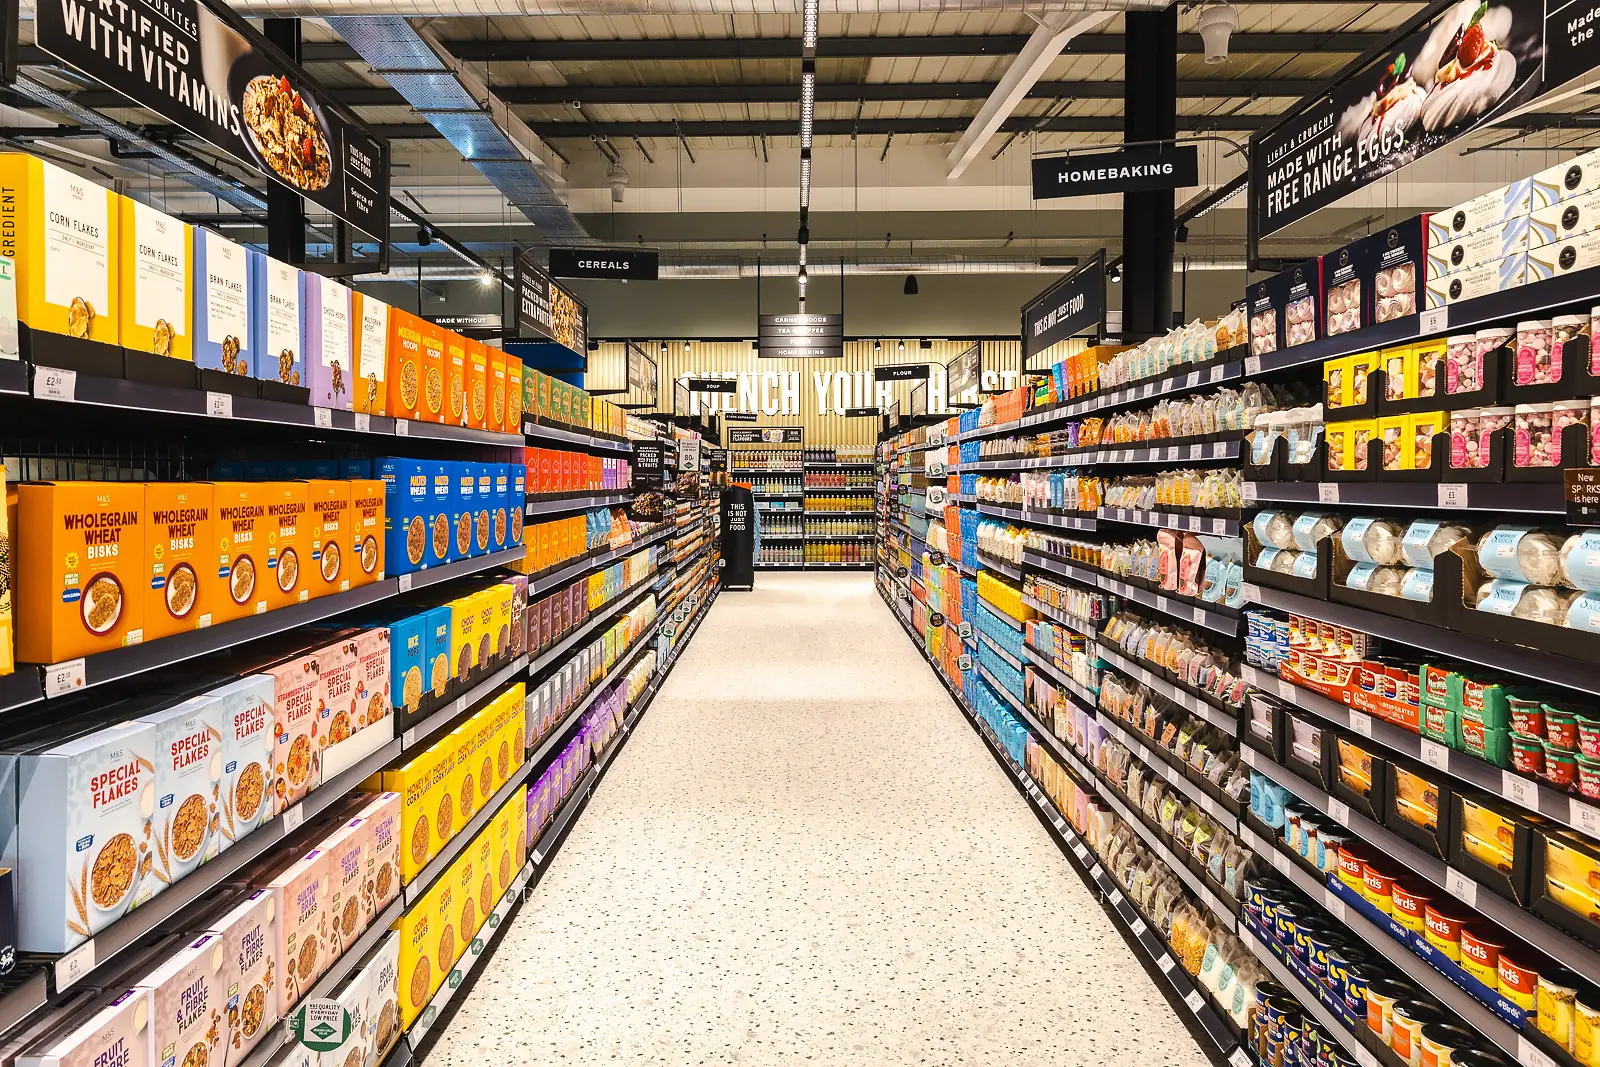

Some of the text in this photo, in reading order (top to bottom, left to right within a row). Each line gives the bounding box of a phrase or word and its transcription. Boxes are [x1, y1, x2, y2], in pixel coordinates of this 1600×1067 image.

[148, 0, 198, 37] URITES
[1567, 7, 1600, 34] Made
[1571, 28, 1594, 47] the
[62, 0, 241, 136] WITH VITAMINS
[1267, 113, 1334, 164] LIGHT & CRUNCHY
[363, 155, 371, 168] NOT
[1267, 131, 1342, 190] MADE WITH
[1267, 119, 1404, 218] FREE RANGE EGGS
[360, 163, 372, 178] FOOD
[1058, 163, 1173, 184] HOMEBAKING
[350, 187, 367, 204] Source
[356, 200, 369, 214] fibre
[49, 211, 99, 239] CORN FLAKES
[139, 244, 179, 267] CORN FLAKES
[578, 260, 630, 270] CEREALS
[209, 274, 243, 293] BRAN FLAKES
[521, 285, 539, 304] PACKED
[521, 297, 537, 320] EXTRA
[1034, 293, 1084, 338] THIS IS NOT JUST FOOD
[1577, 474, 1595, 482] New
[410, 487, 427, 496] WHEATS
[1574, 494, 1599, 504] is here
[267, 502, 306, 516] WHOLEGRAIN
[313, 500, 348, 512] WHOLEGRAIN
[354, 497, 384, 508] WHOLEGRAIN
[64, 511, 138, 531] WHOLEGRAIN
[153, 508, 208, 525] WHOLEGRAIN
[219, 505, 264, 521] WHOLEGRAIN
[278, 515, 298, 527] WHEAT
[323, 511, 340, 523] WHEAT
[362, 508, 377, 518] WHEAT
[363, 517, 376, 527] BISKS
[168, 523, 196, 539] WHEAT
[232, 519, 255, 532] WHEAT
[280, 527, 296, 538] BISKS
[323, 521, 339, 532] BISKS
[84, 528, 122, 546] WHEAT
[170, 537, 194, 551] BISKS
[234, 531, 253, 544] BISKS
[86, 544, 119, 561] BISKS
[461, 615, 475, 629] CHOCO
[407, 634, 419, 649] RICE
[365, 656, 385, 671] SPECIAL
[327, 670, 351, 689] SPECIAL
[366, 666, 384, 681] FLAKES
[277, 687, 303, 703] STRAWBERRY
[328, 681, 350, 700] FLAKES
[286, 690, 312, 711] SPECIAL
[1381, 701, 1415, 718] EVAPORATED
[234, 703, 266, 727] SPECIAL
[287, 702, 311, 723] FLAKES
[1392, 711, 1405, 721] MILK
[235, 717, 264, 741] FLAKES
[170, 728, 211, 756] SPECIAL
[173, 744, 209, 771] FLAKES
[90, 759, 141, 792] SPECIAL
[92, 776, 139, 809] FLAKES
[406, 778, 424, 798] HONEY
[1512, 783, 1524, 796] 90p
[375, 816, 393, 836] SULTANA
[378, 827, 391, 843] BRAN
[341, 845, 361, 868] SULTANA
[1339, 856, 1360, 873] Bird's
[344, 857, 358, 877] BRAN
[297, 879, 319, 906] SULTANA
[1456, 880, 1464, 890] £2
[301, 892, 316, 913] BRAN
[1392, 892, 1417, 911] Bird's
[298, 902, 317, 926] FLAKES
[1425, 913, 1450, 935] Bird's
[241, 924, 261, 950] FRUIT
[245, 933, 264, 958] FIBRE
[1461, 938, 1488, 960] Bird's
[69, 959, 78, 971] £2
[240, 948, 263, 975] FLAKES
[1467, 965, 1485, 975] Custard
[1498, 961, 1520, 985] ird's
[180, 975, 205, 1006] FRUIT
[185, 985, 209, 1016] FIBRE
[1502, 1001, 1520, 1019] Bird's
[178, 1000, 207, 1035] FLAKES
[93, 1036, 124, 1067] FRUIT
